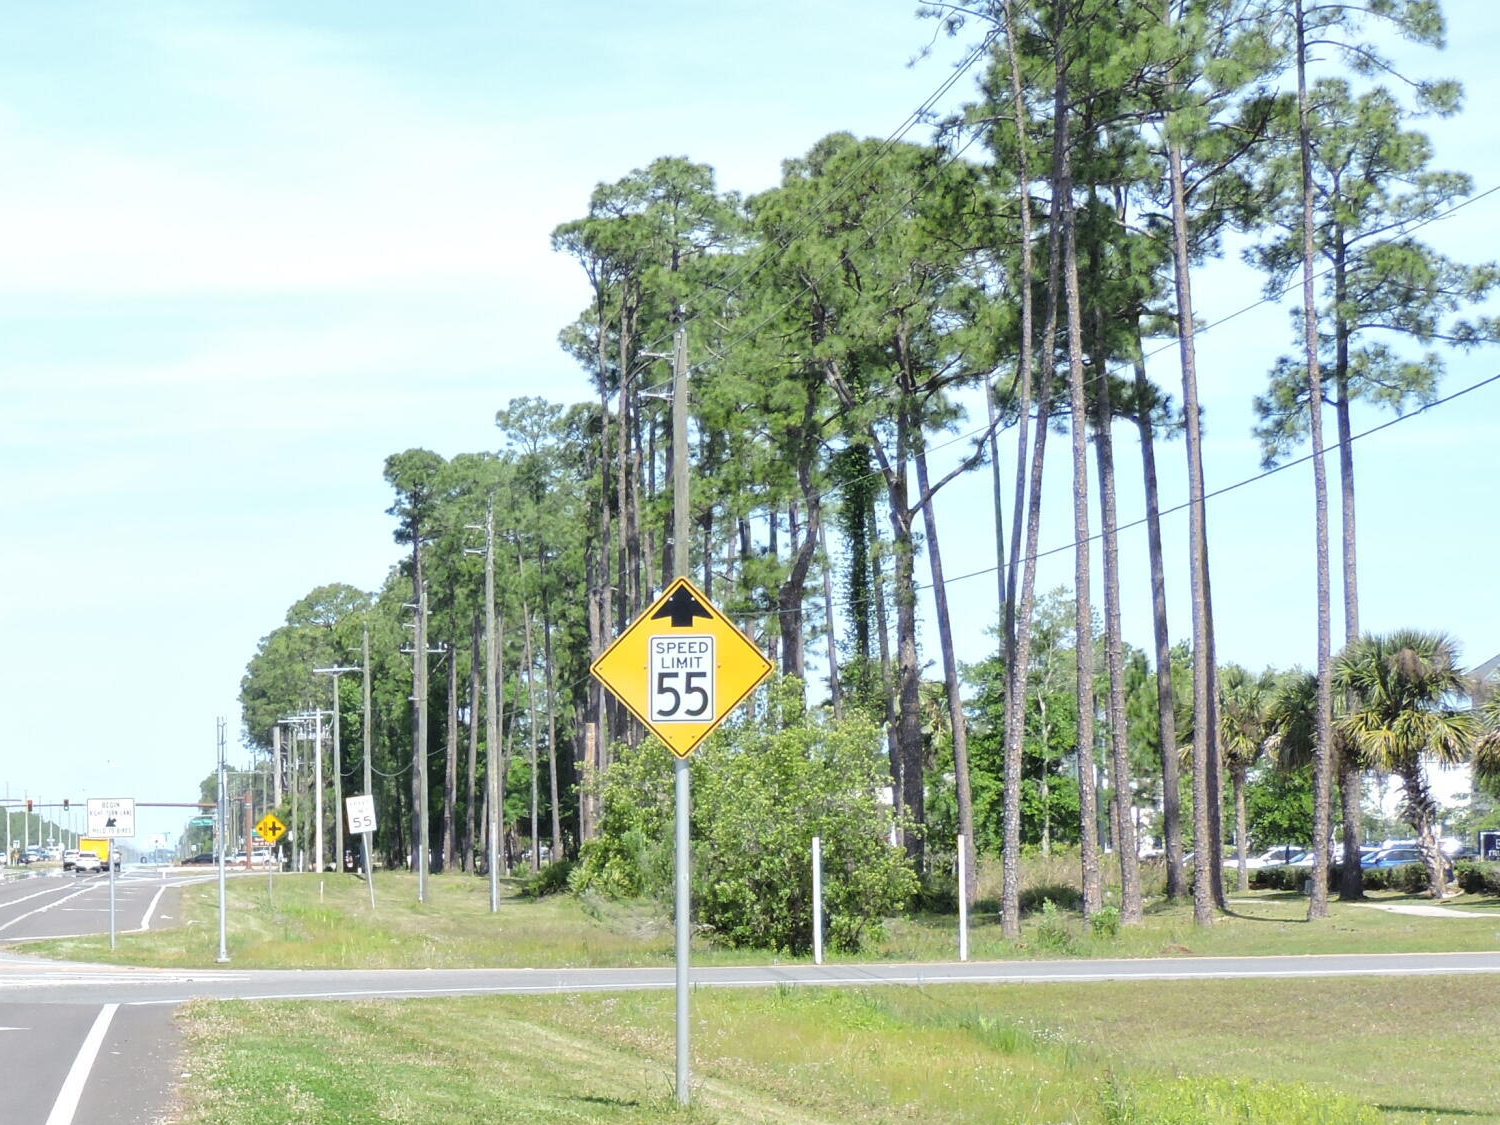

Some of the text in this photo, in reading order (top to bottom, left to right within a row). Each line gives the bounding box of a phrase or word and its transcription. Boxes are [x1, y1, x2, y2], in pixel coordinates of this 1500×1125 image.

[656, 641, 709, 655] SPEED
[661, 656, 703, 669] LIMIT
[656, 671, 709, 717] 55
[353, 815, 372, 829] 55
